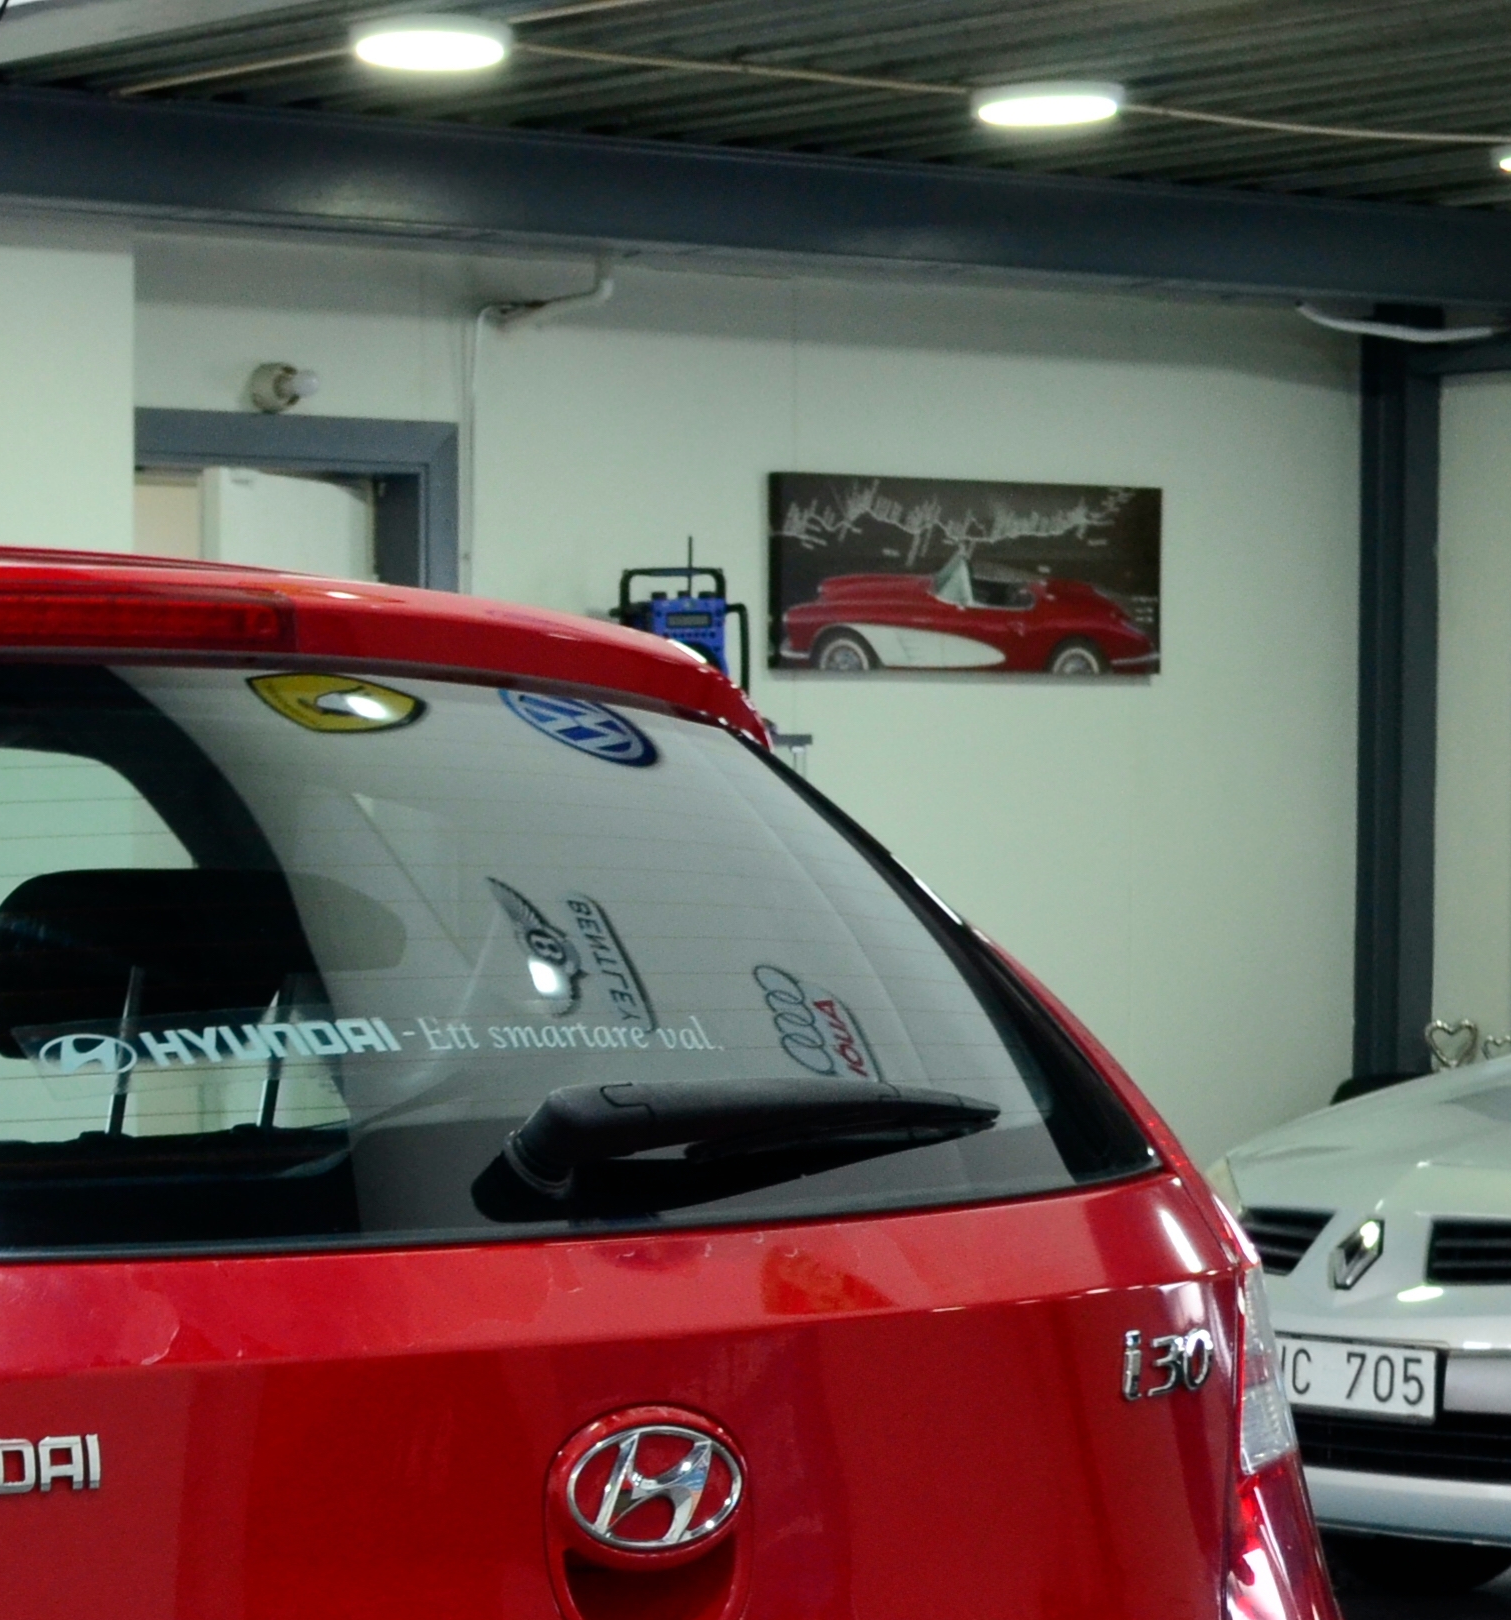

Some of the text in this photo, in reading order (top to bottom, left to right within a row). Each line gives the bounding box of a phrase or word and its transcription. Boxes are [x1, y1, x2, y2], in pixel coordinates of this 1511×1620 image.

[138, 1016, 402, 1067] HYUNDAI
[417, 1016, 480, 1051] Ett
[488, 1020, 650, 1050] smartare
[657, 1015, 725, 1051] val.
[1120, 1328, 1214, 1401] i30
[1345, 1351, 1425, 1407] 705
